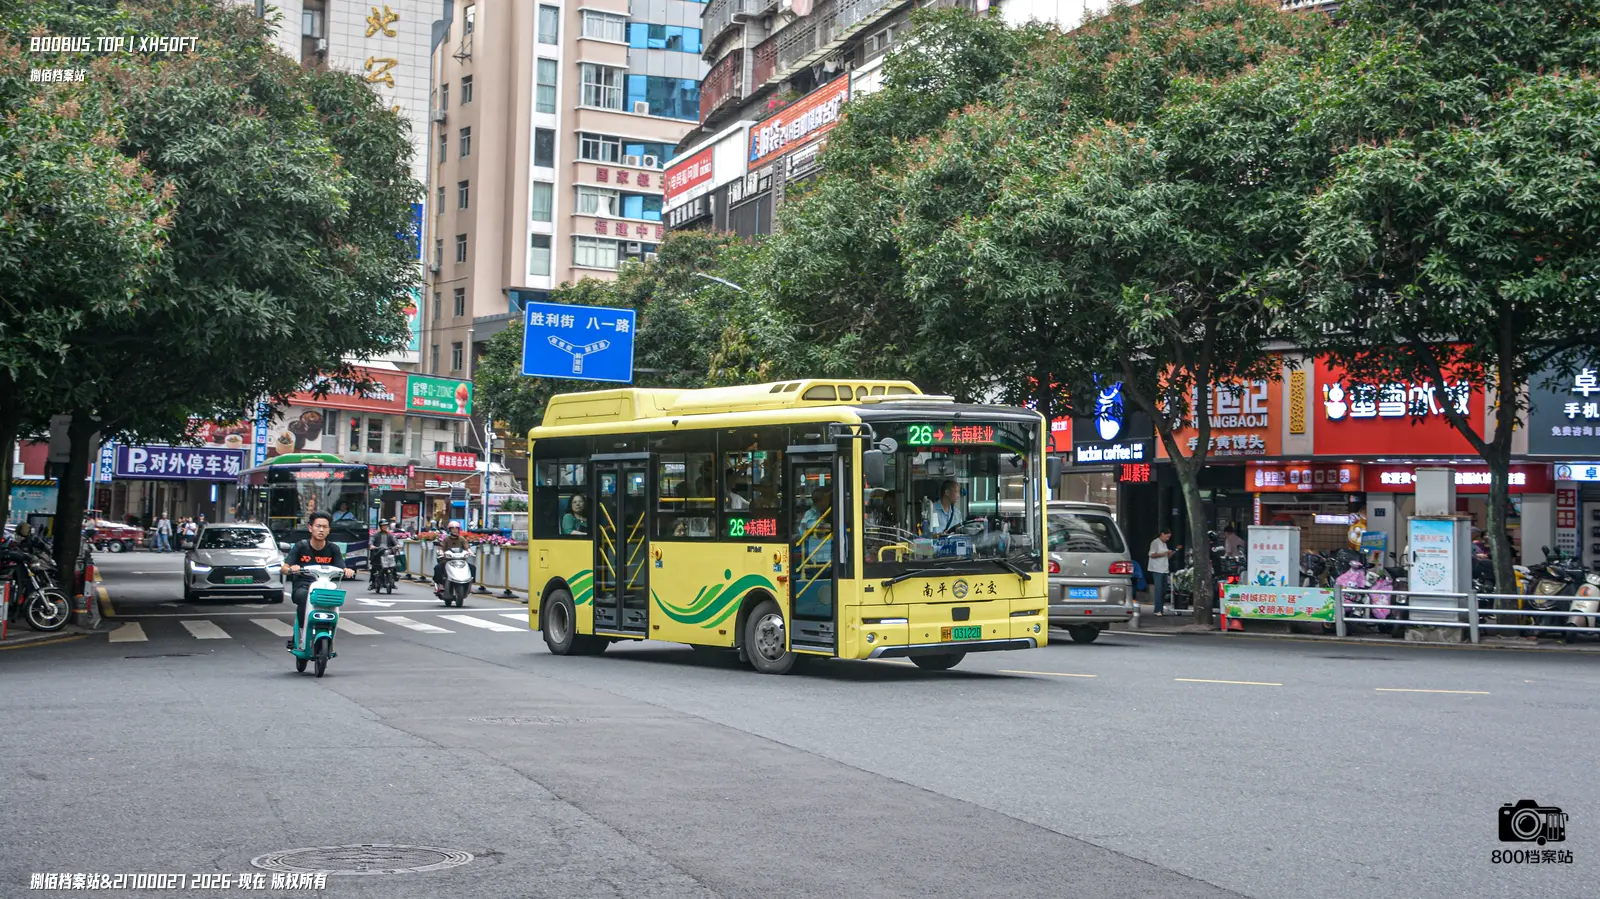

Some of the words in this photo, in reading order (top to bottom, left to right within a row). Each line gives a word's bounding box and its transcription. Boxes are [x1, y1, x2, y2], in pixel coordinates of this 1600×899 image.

[365, 5, 400, 113] 北公
[530, 312, 575, 328] 胜利街
[586, 317, 630, 333] 八一路
[1563, 402, 1600, 418] 手机
[909, 426, 932, 445] 26
[951, 425, 995, 444] 东南鞋业
[1551, 426, 1593, 436] 免费咨询
[1104, 444, 1130, 460] coffee
[149, 453, 240, 476] 对外停车场
[439, 454, 474, 468] 解放综合大楼
[729, 518, 745, 536] 26
[749, 518, 777, 536] 东南鞋业
[922, 583, 948, 598] 南平
[973, 581, 997, 595] 公交
